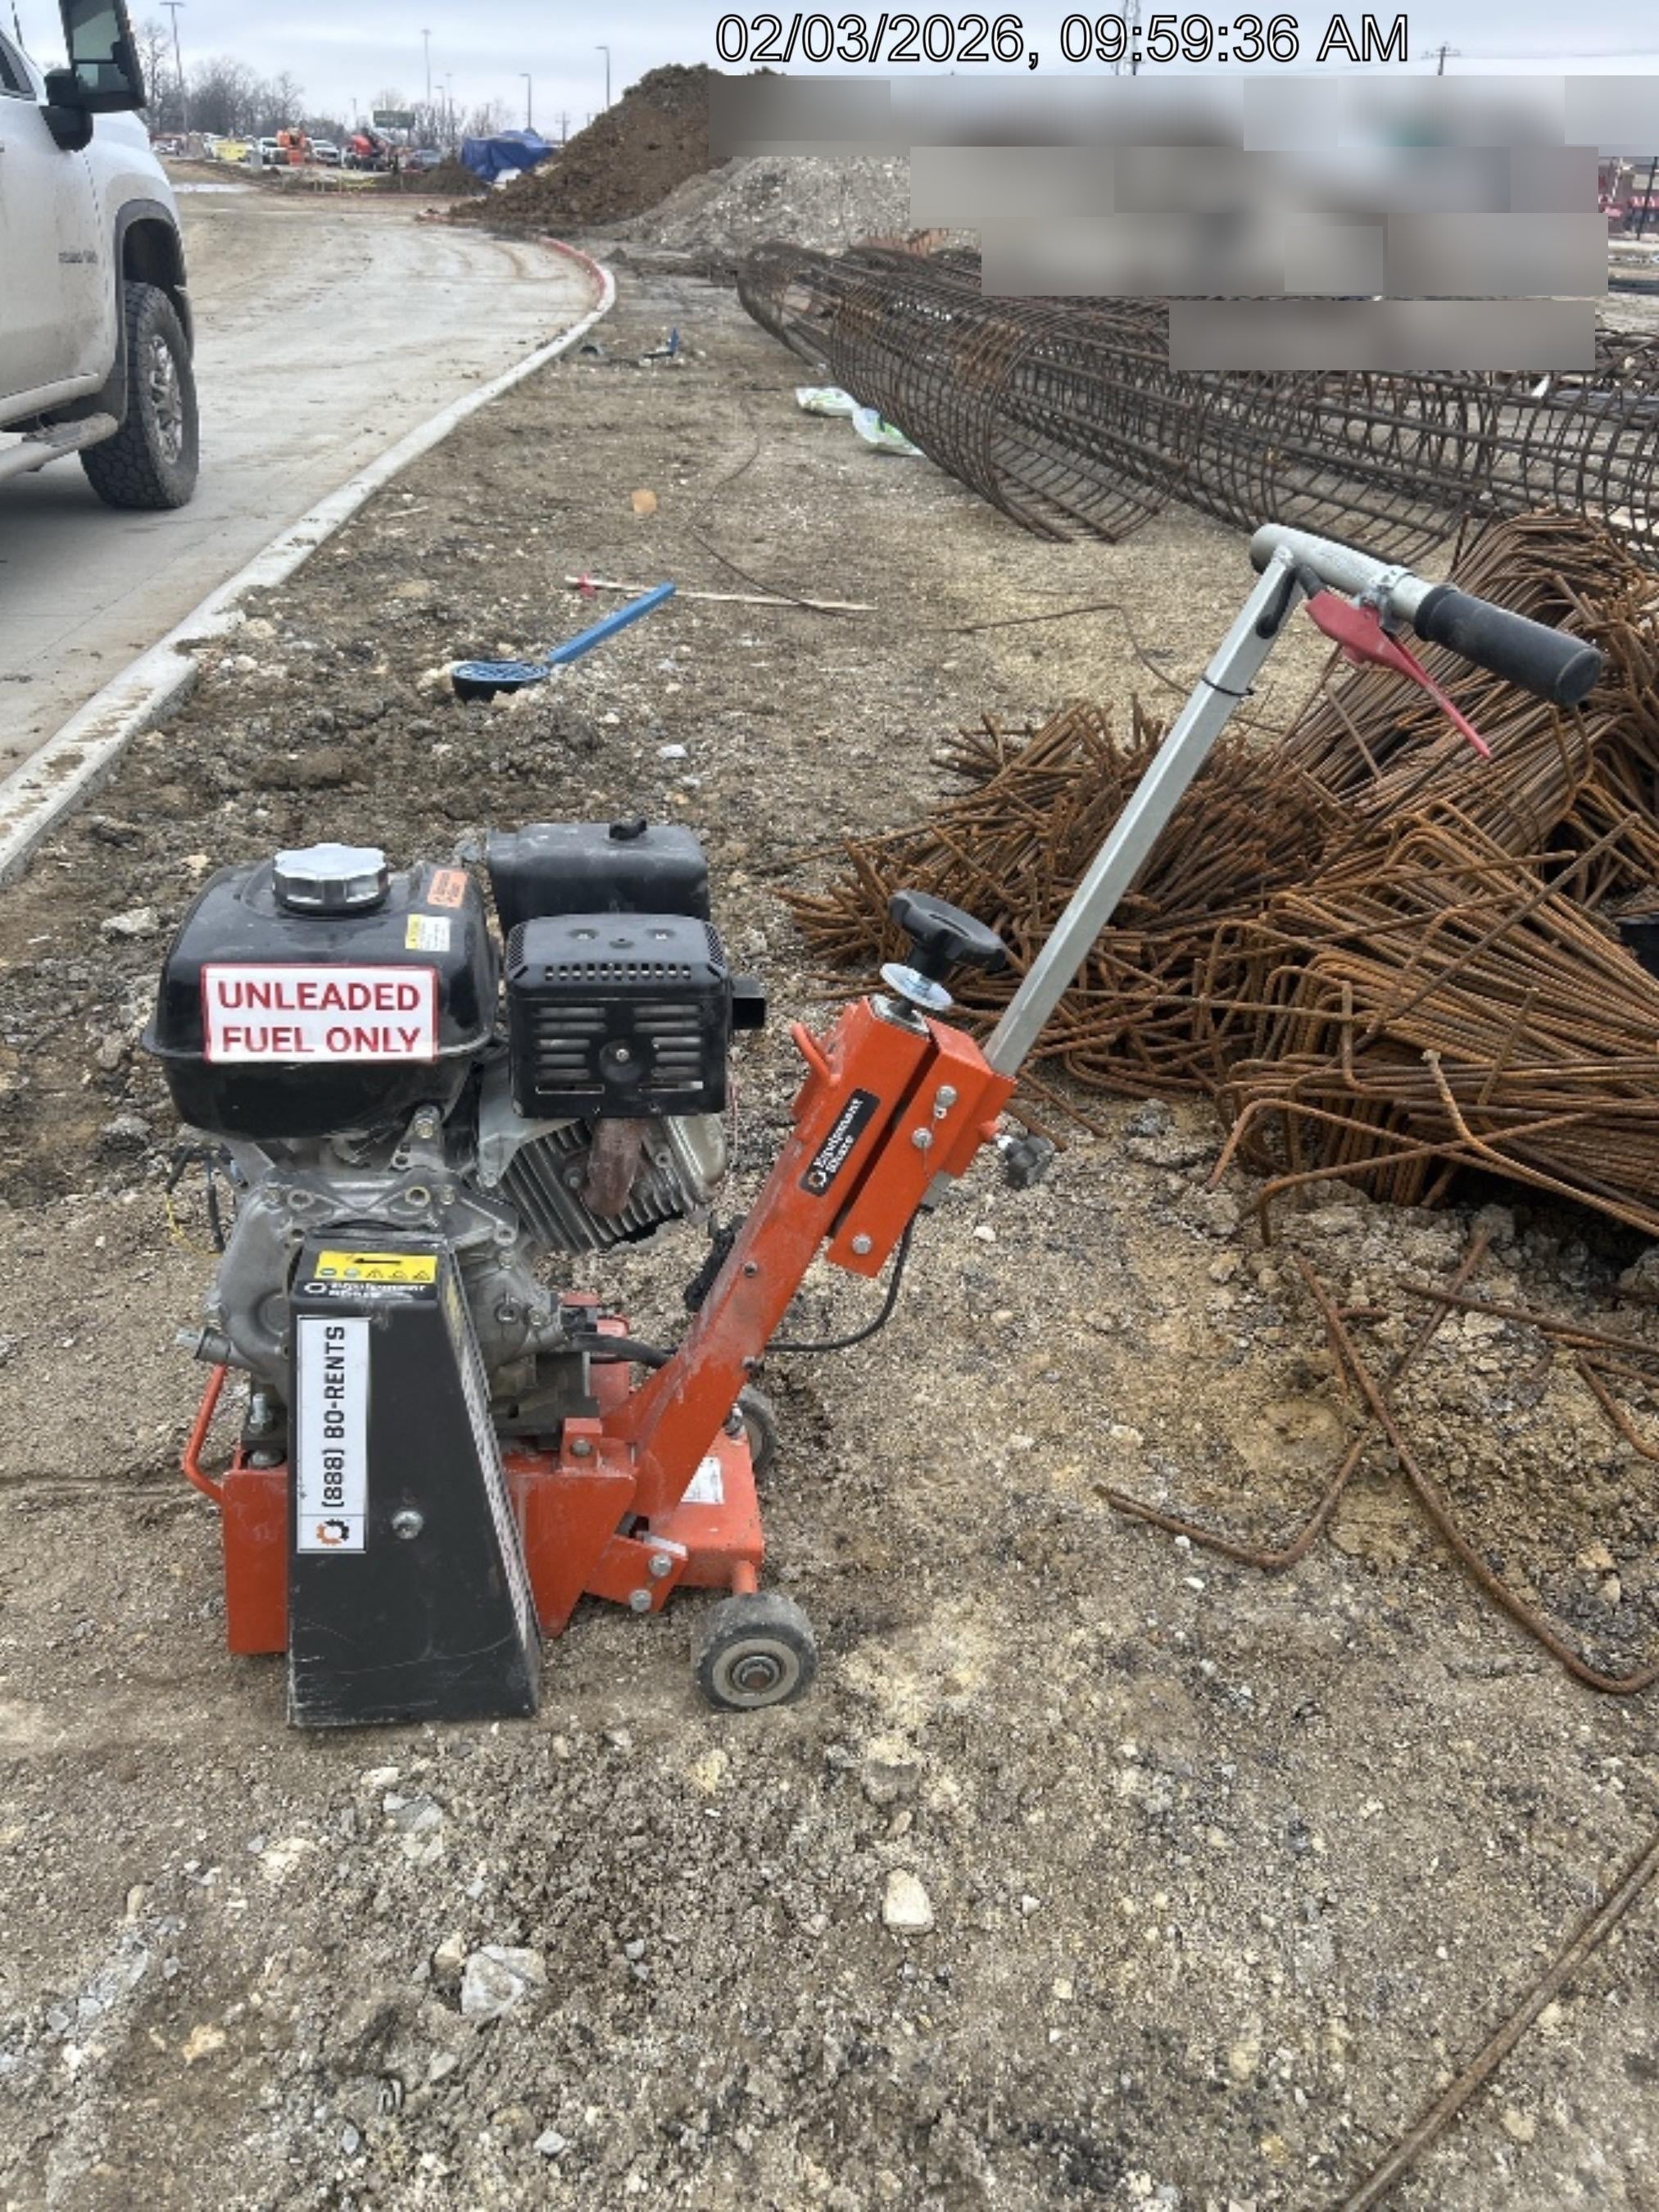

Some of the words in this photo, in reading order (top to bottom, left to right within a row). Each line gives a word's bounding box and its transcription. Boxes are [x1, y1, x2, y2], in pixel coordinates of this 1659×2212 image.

[218, 981, 420, 1011] UNLEADED
[222, 1027, 315, 1053] FUEL
[326, 1027, 420, 1053] ONLY
[321, 1448, 345, 1507] (888)
